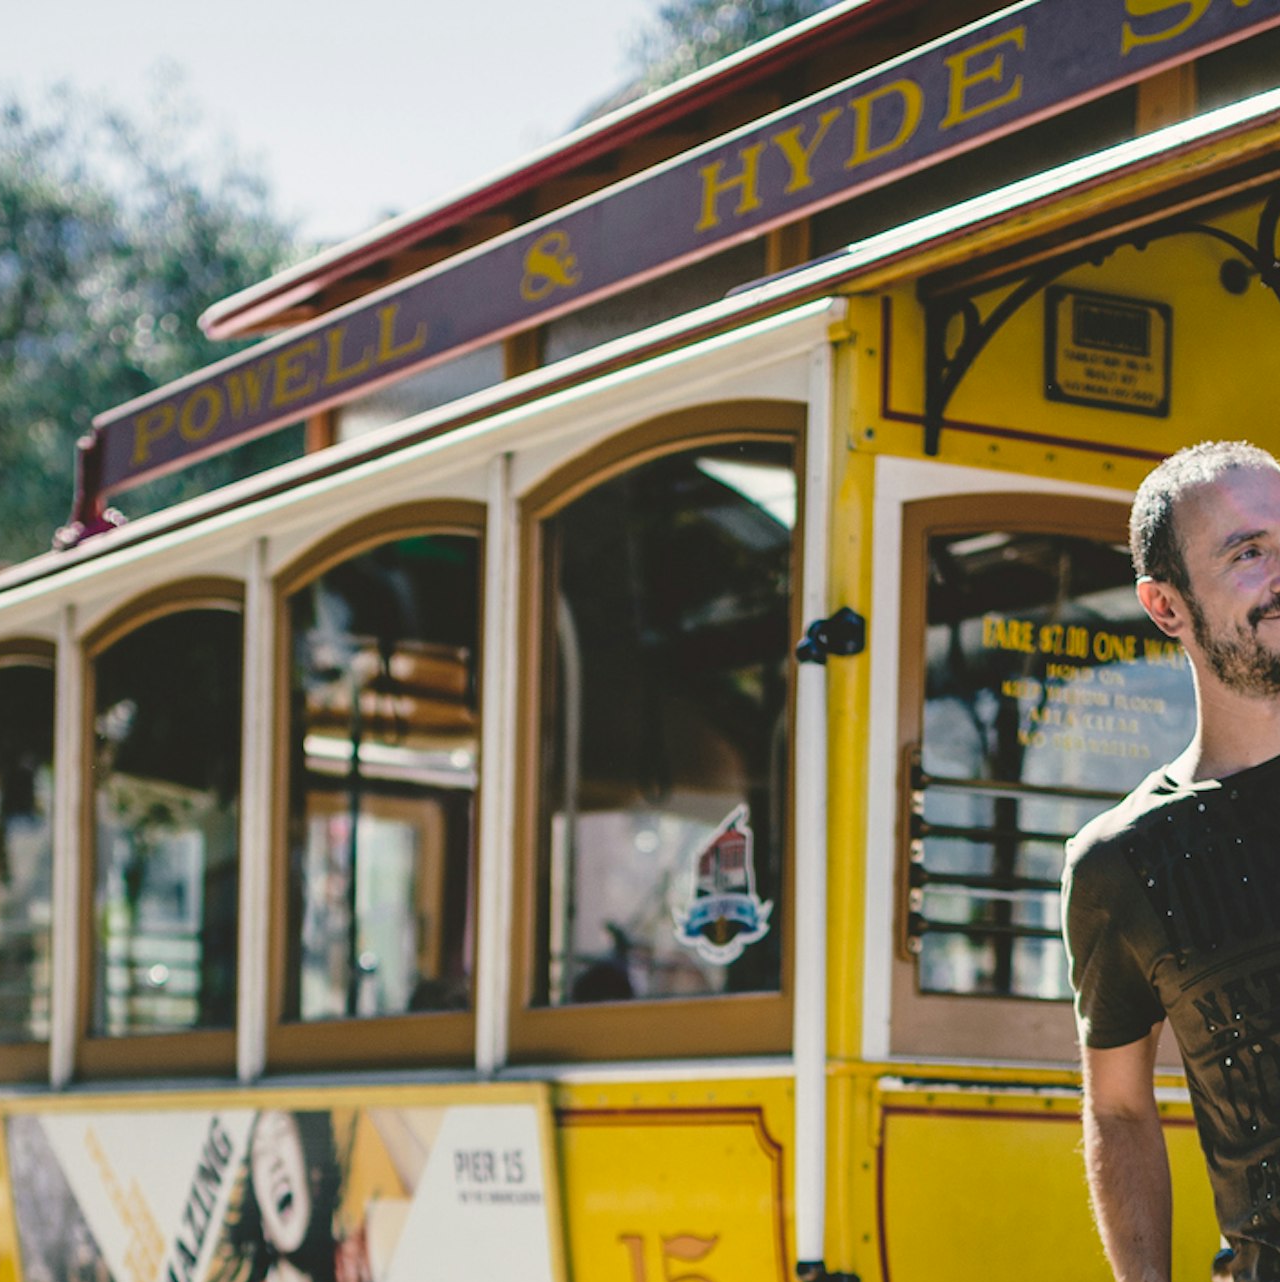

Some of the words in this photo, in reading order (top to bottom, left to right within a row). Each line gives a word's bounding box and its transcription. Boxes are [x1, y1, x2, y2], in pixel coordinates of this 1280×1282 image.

[130, 304, 426, 466] POWELL
[521, 229, 579, 301] &
[694, 27, 1026, 232] HYDE
[1092, 630, 1137, 663] ONE
[455, 1149, 497, 1184] PIER
[503, 1150, 526, 1184] 15
